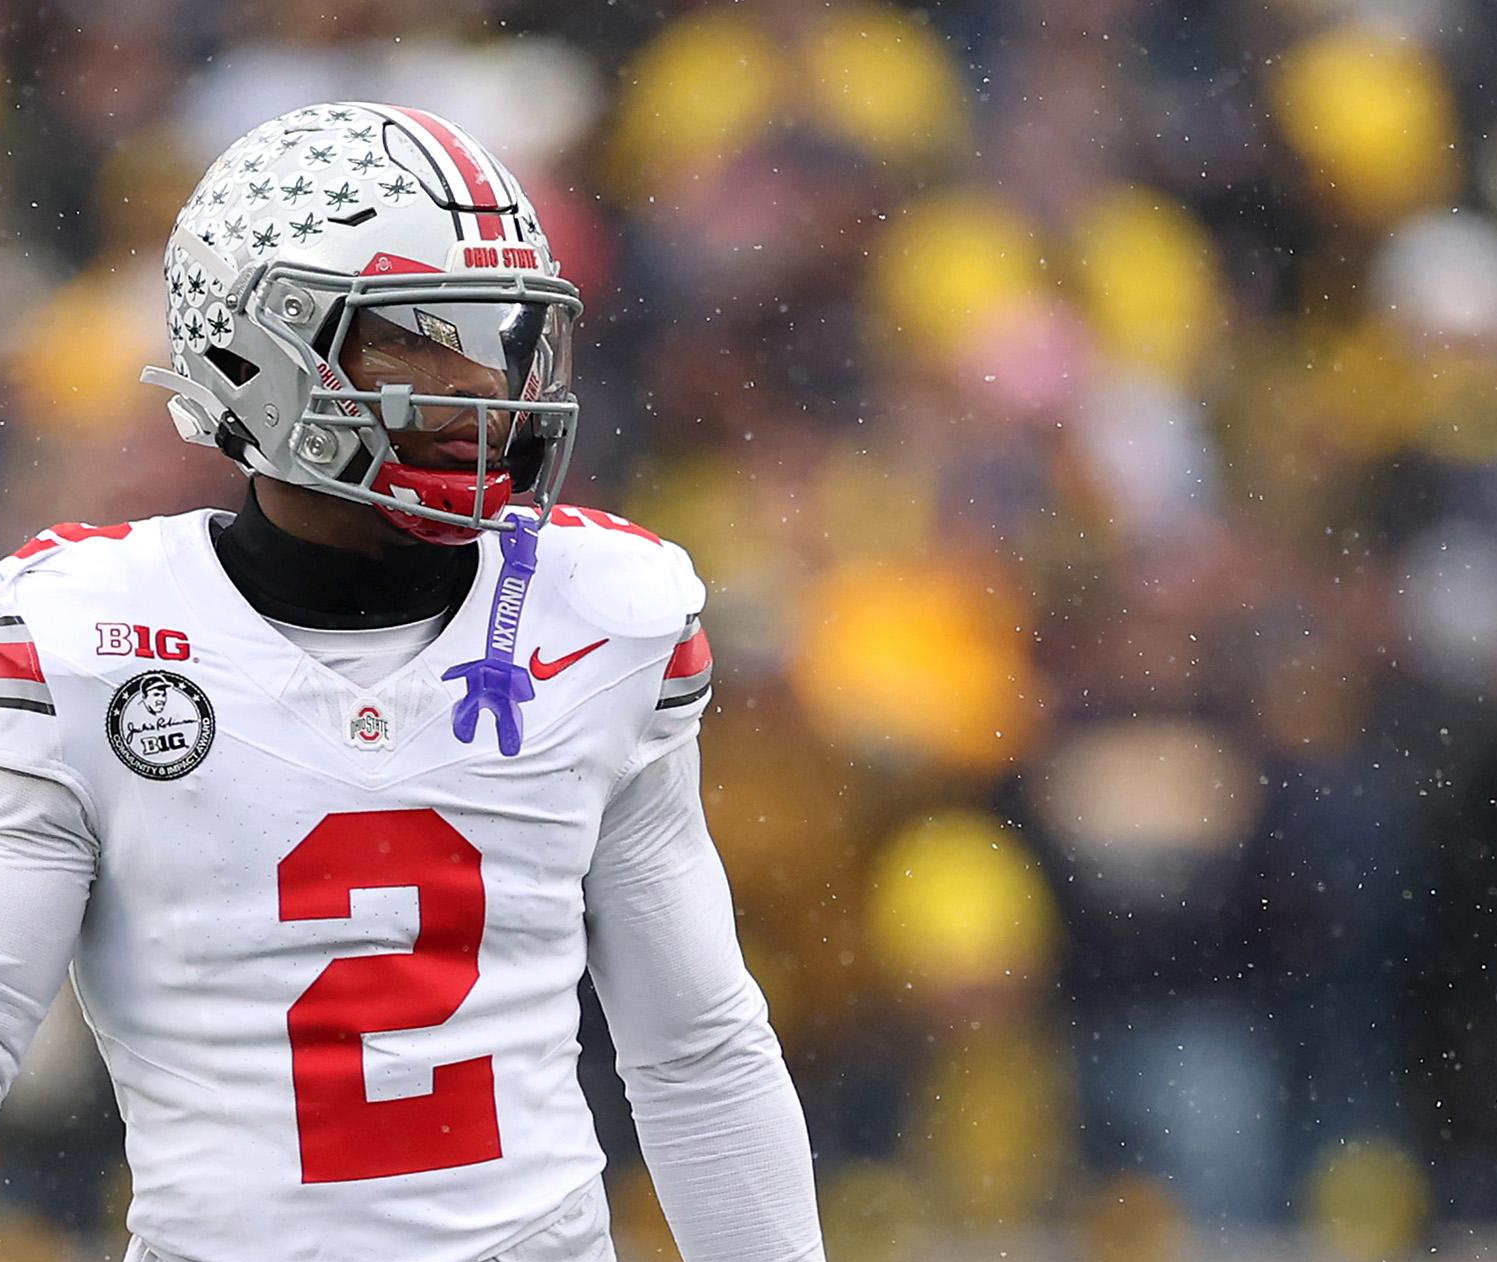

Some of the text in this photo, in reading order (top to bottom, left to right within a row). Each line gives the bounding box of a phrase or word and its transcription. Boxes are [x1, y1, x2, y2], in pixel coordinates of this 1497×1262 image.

[464, 247, 539, 270] OHIO STATE
[492, 576, 526, 654] NXTRND
[113, 734, 158, 775] COMMUNITY
[167, 752, 198, 774] IMPACT
[197, 717, 210, 753] AWARD
[277, 808, 503, 1184] 2
